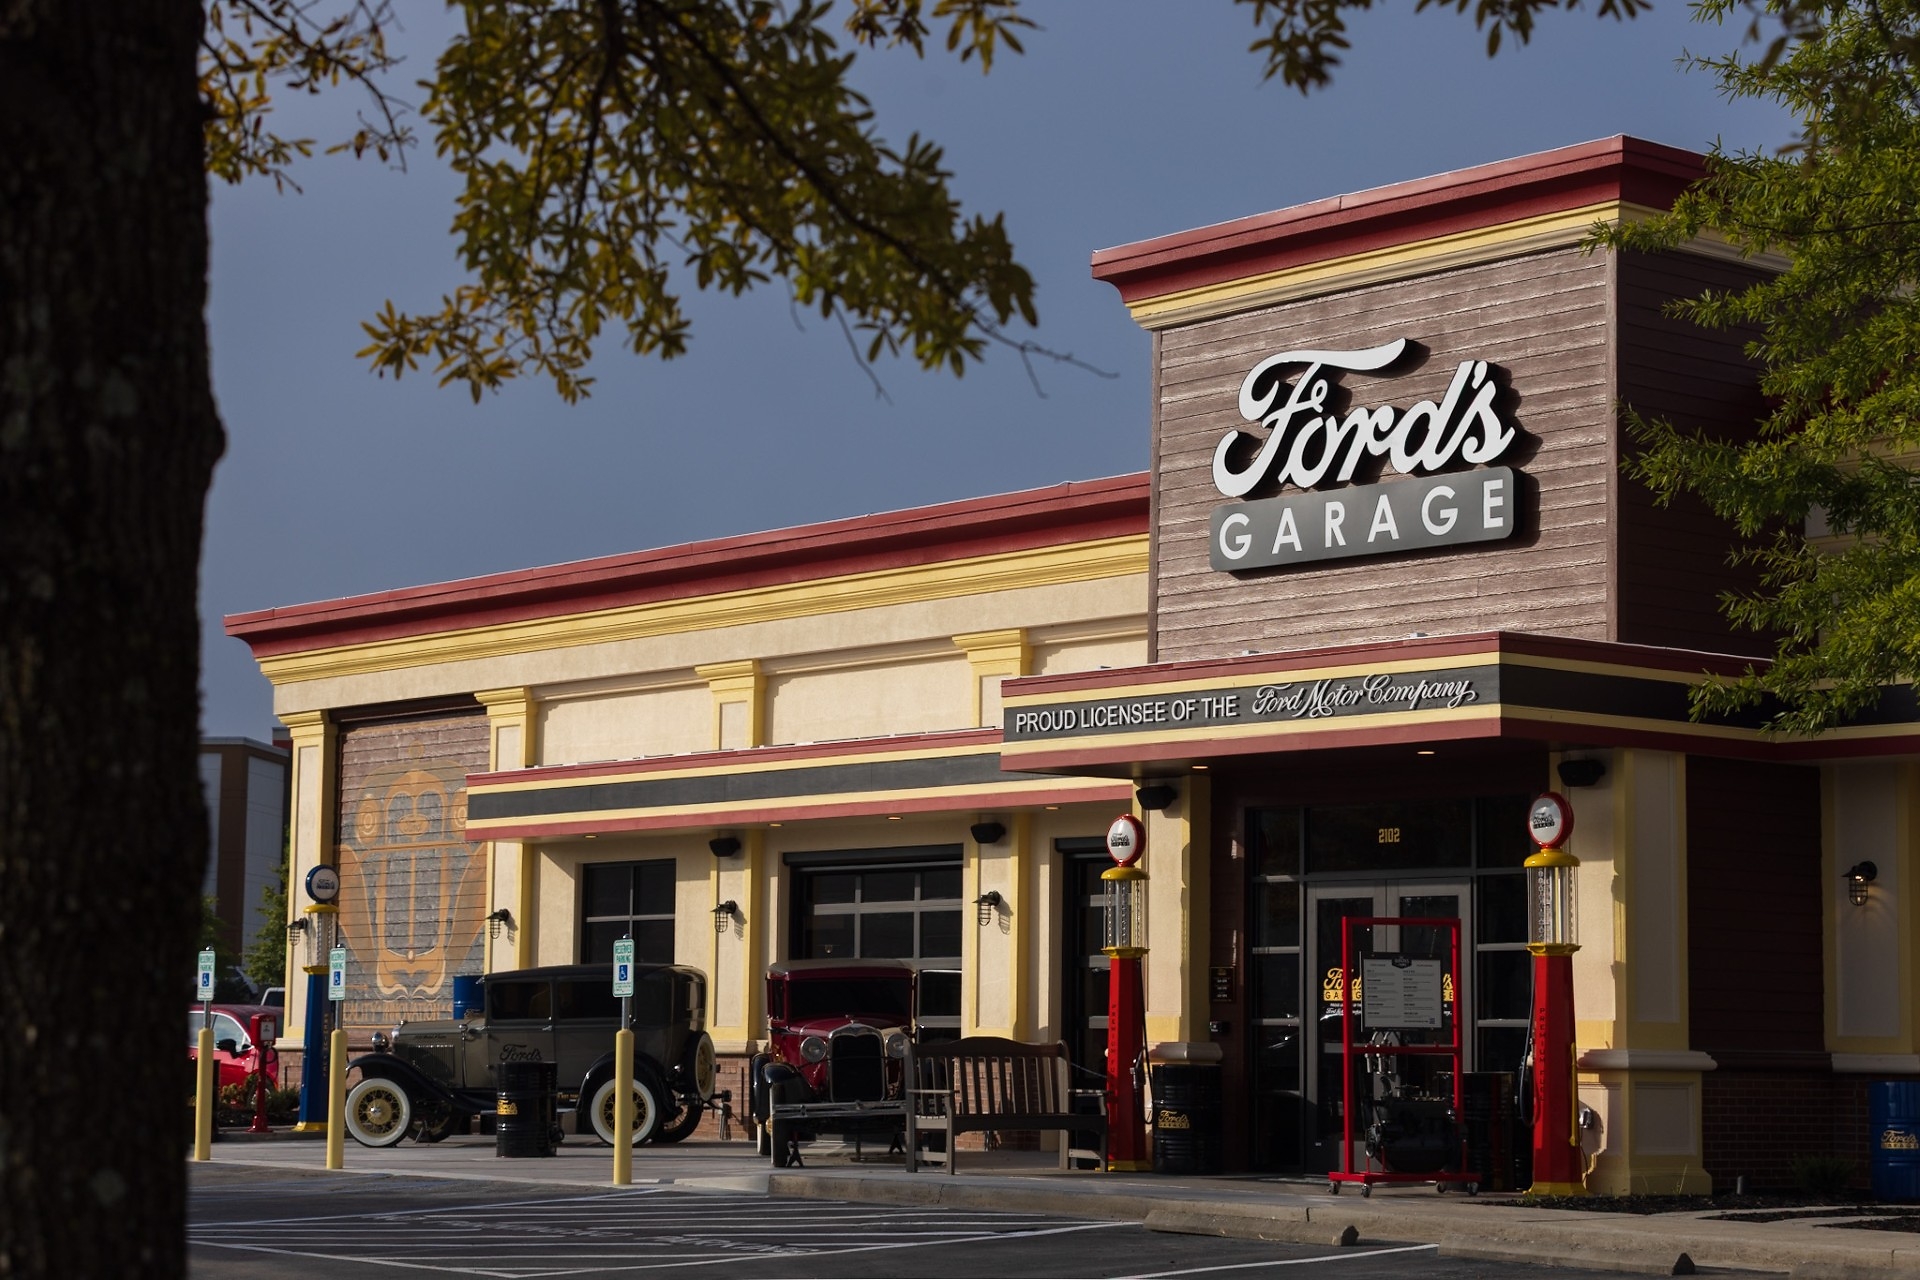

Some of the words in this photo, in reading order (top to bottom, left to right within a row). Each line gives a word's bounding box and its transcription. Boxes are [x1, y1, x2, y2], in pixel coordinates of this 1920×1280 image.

[1211, 338, 1516, 498] Ford's
[1218, 479, 1505, 561] GARAGE
[1015, 708, 1076, 733] PROUD
[1080, 701, 1166, 729] LICENSEE
[1170, 698, 1198, 721] OF
[1200, 695, 1238, 719] THE
[1251, 682, 1304, 715] Ford
[1291, 678, 1364, 718] Motor
[1362, 673, 1478, 709] Company
[1378, 828, 1400, 844] 2102
